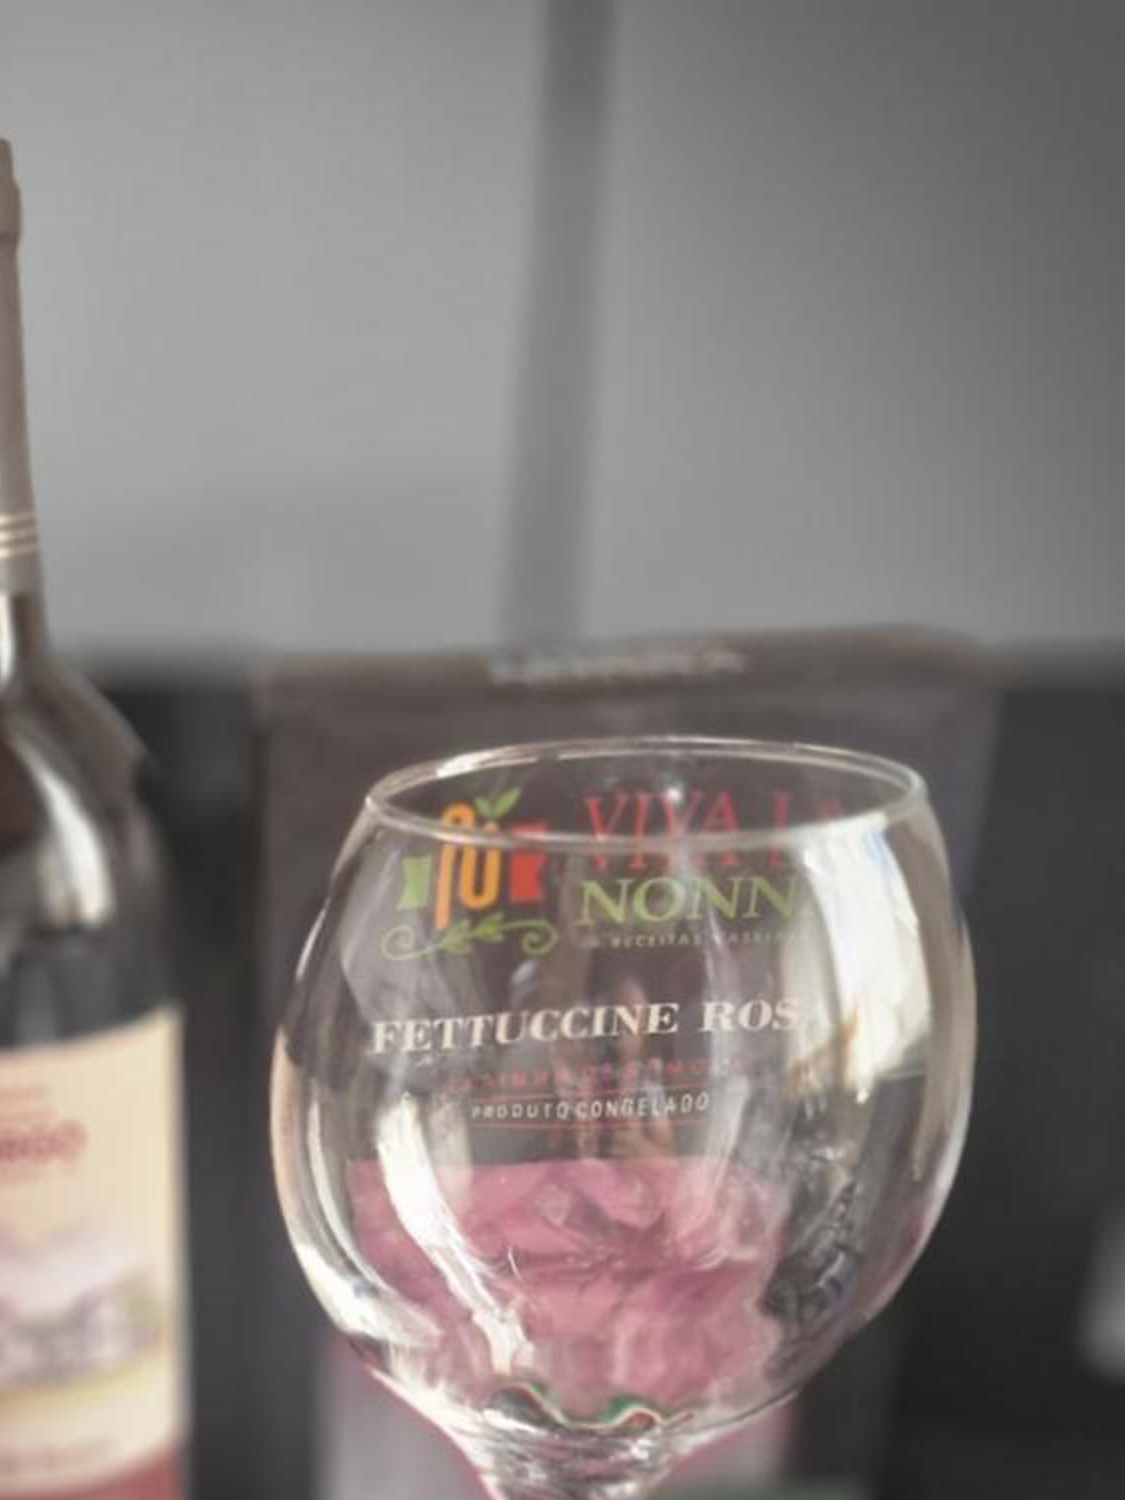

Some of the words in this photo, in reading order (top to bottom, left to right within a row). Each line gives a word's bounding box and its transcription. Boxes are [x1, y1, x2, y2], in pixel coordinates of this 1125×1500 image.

[584, 790, 741, 869] VIVA
[576, 875, 796, 926] NONN
[370, 1001, 679, 1055] FETTUCCINE
[472, 1100, 571, 1120] PRODUTO
[575, 1091, 710, 1119] CONGELADO
